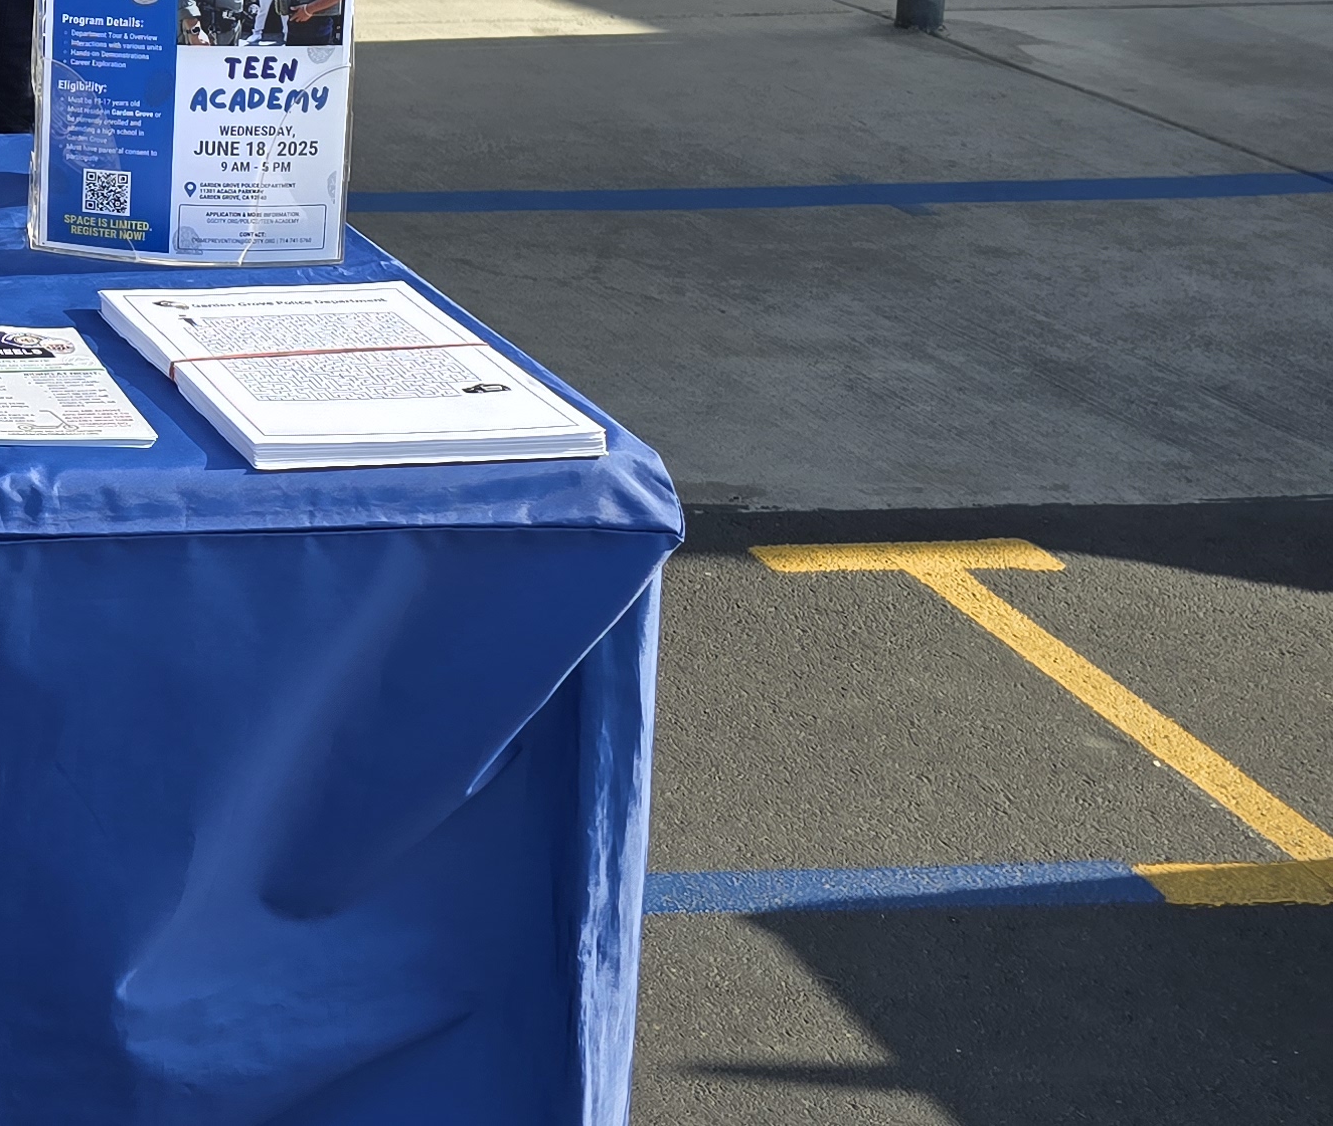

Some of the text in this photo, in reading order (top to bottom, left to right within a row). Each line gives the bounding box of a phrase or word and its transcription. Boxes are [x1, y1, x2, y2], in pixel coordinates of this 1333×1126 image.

[62, 14, 144, 28] Program Details:
[224, 55, 298, 84] TEEN
[58, 80, 107, 93] Eligibility:
[189, 86, 330, 113] ACADEMY
[219, 125, 296, 138] WEDNESDAY,
[193, 141, 240, 157] JUNE
[277, 140, 318, 157] 2025
[221, 162, 227, 172] 9
[231, 162, 250, 172] AM
[262, 162, 269, 172] 5
[273, 162, 291, 172] PM
[64, 214, 152, 231] SPACE IS LIMITED.
[71, 225, 146, 241] REGISTER NOW!
